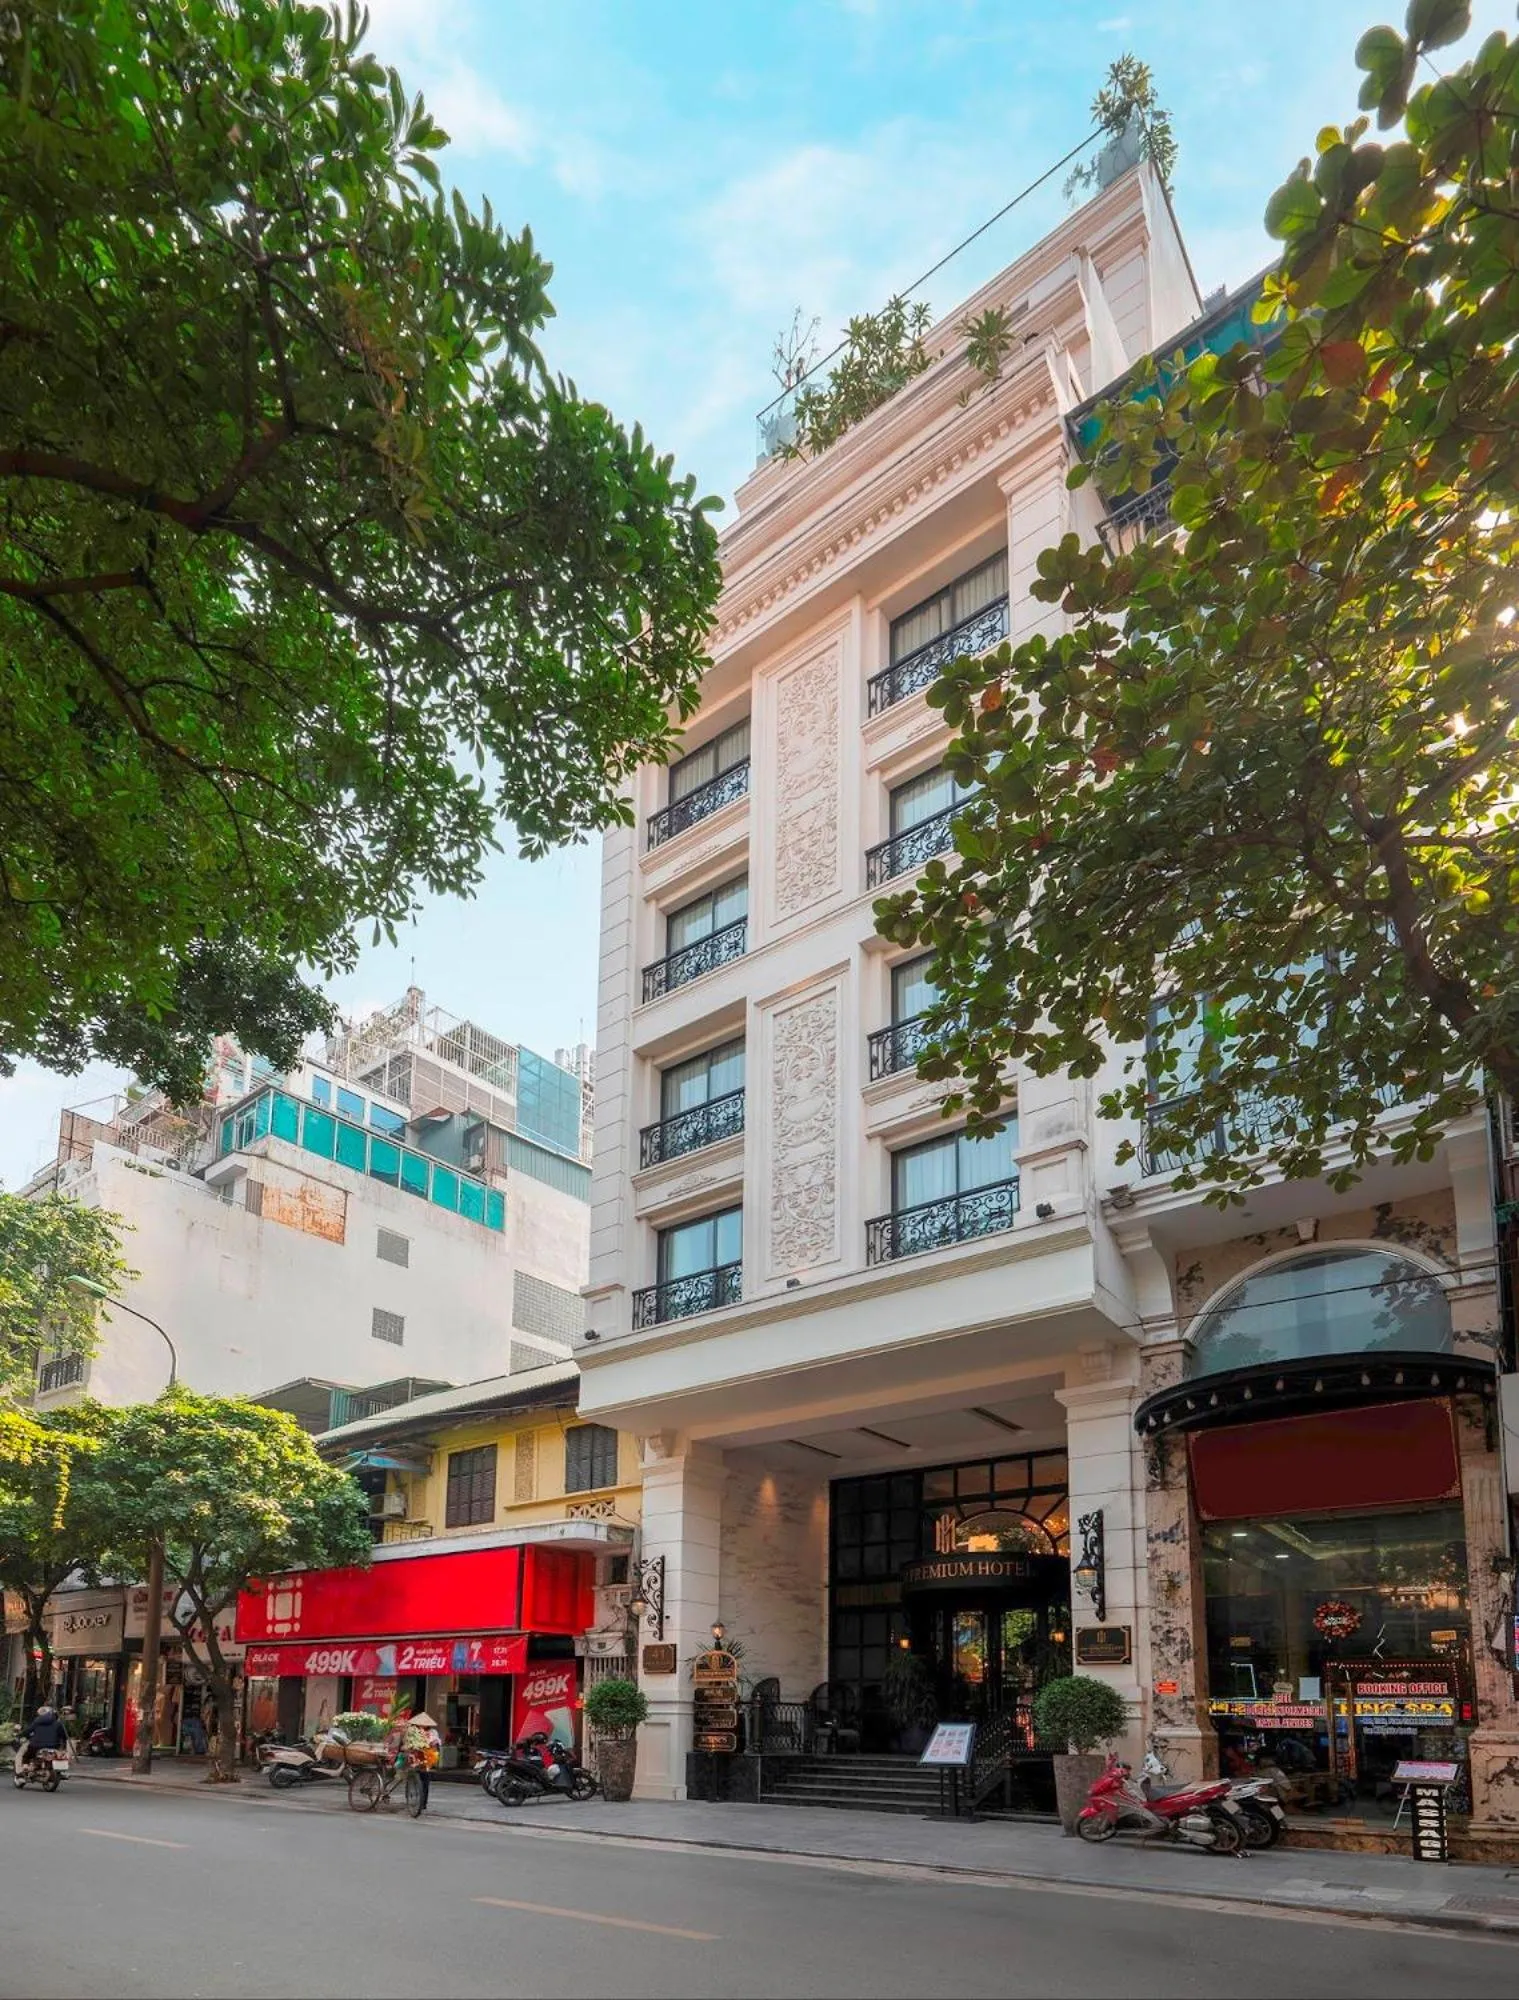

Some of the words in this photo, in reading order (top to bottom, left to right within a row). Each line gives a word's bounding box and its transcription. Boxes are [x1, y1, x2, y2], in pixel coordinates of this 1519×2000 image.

[909, 1562, 974, 1582] PREMIUM
[305, 1650, 358, 1674] 499K
[398, 1646, 415, 1670] 2
[522, 1673, 571, 1700] 499K
[1357, 1682, 1407, 1696] BOOKING
[1408, 1682, 1448, 1695] OFFICE
[1416, 1787, 1441, 1859] MASSAGE
